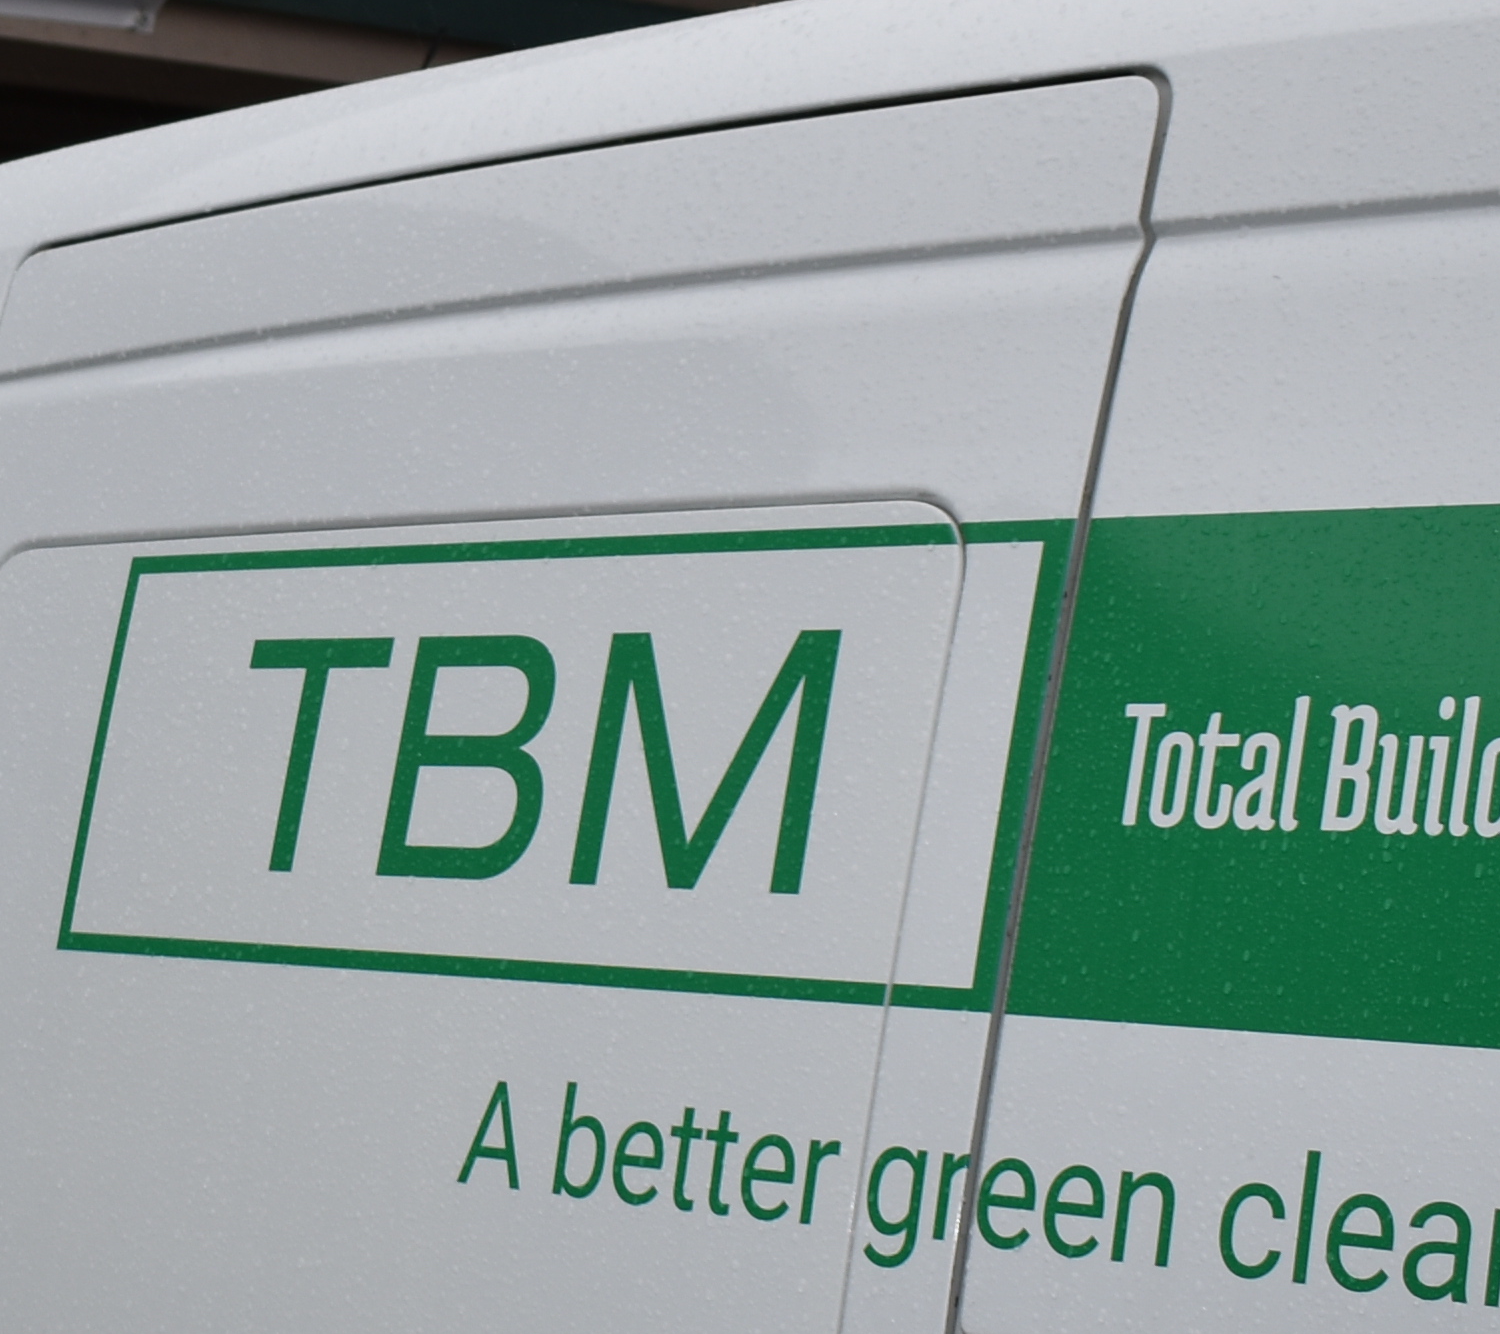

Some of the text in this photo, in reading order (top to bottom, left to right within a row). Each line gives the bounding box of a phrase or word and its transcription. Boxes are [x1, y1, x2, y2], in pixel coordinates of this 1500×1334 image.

[250, 629, 843, 895] TBM
[1121, 695, 1312, 832] Total
[457, 1081, 520, 1191] A
[552, 1082, 842, 1225] better
[863, 1144, 1177, 1269] green
